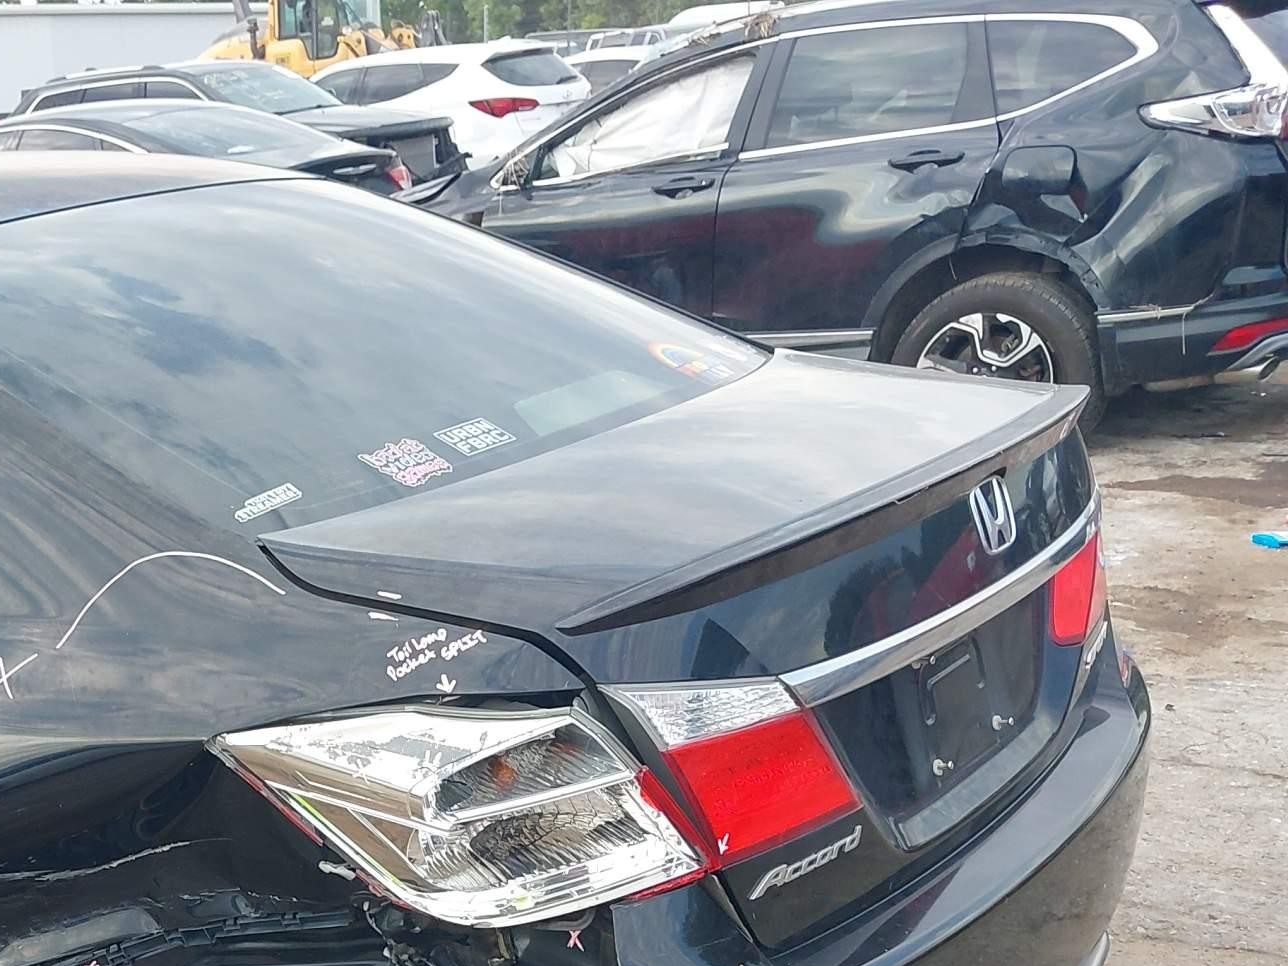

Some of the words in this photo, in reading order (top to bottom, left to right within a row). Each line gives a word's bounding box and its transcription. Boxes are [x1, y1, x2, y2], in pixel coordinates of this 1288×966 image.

[439, 420, 496, 443] URBN
[455, 429, 510, 453] FBRC
[747, 824, 862, 900] Accord
